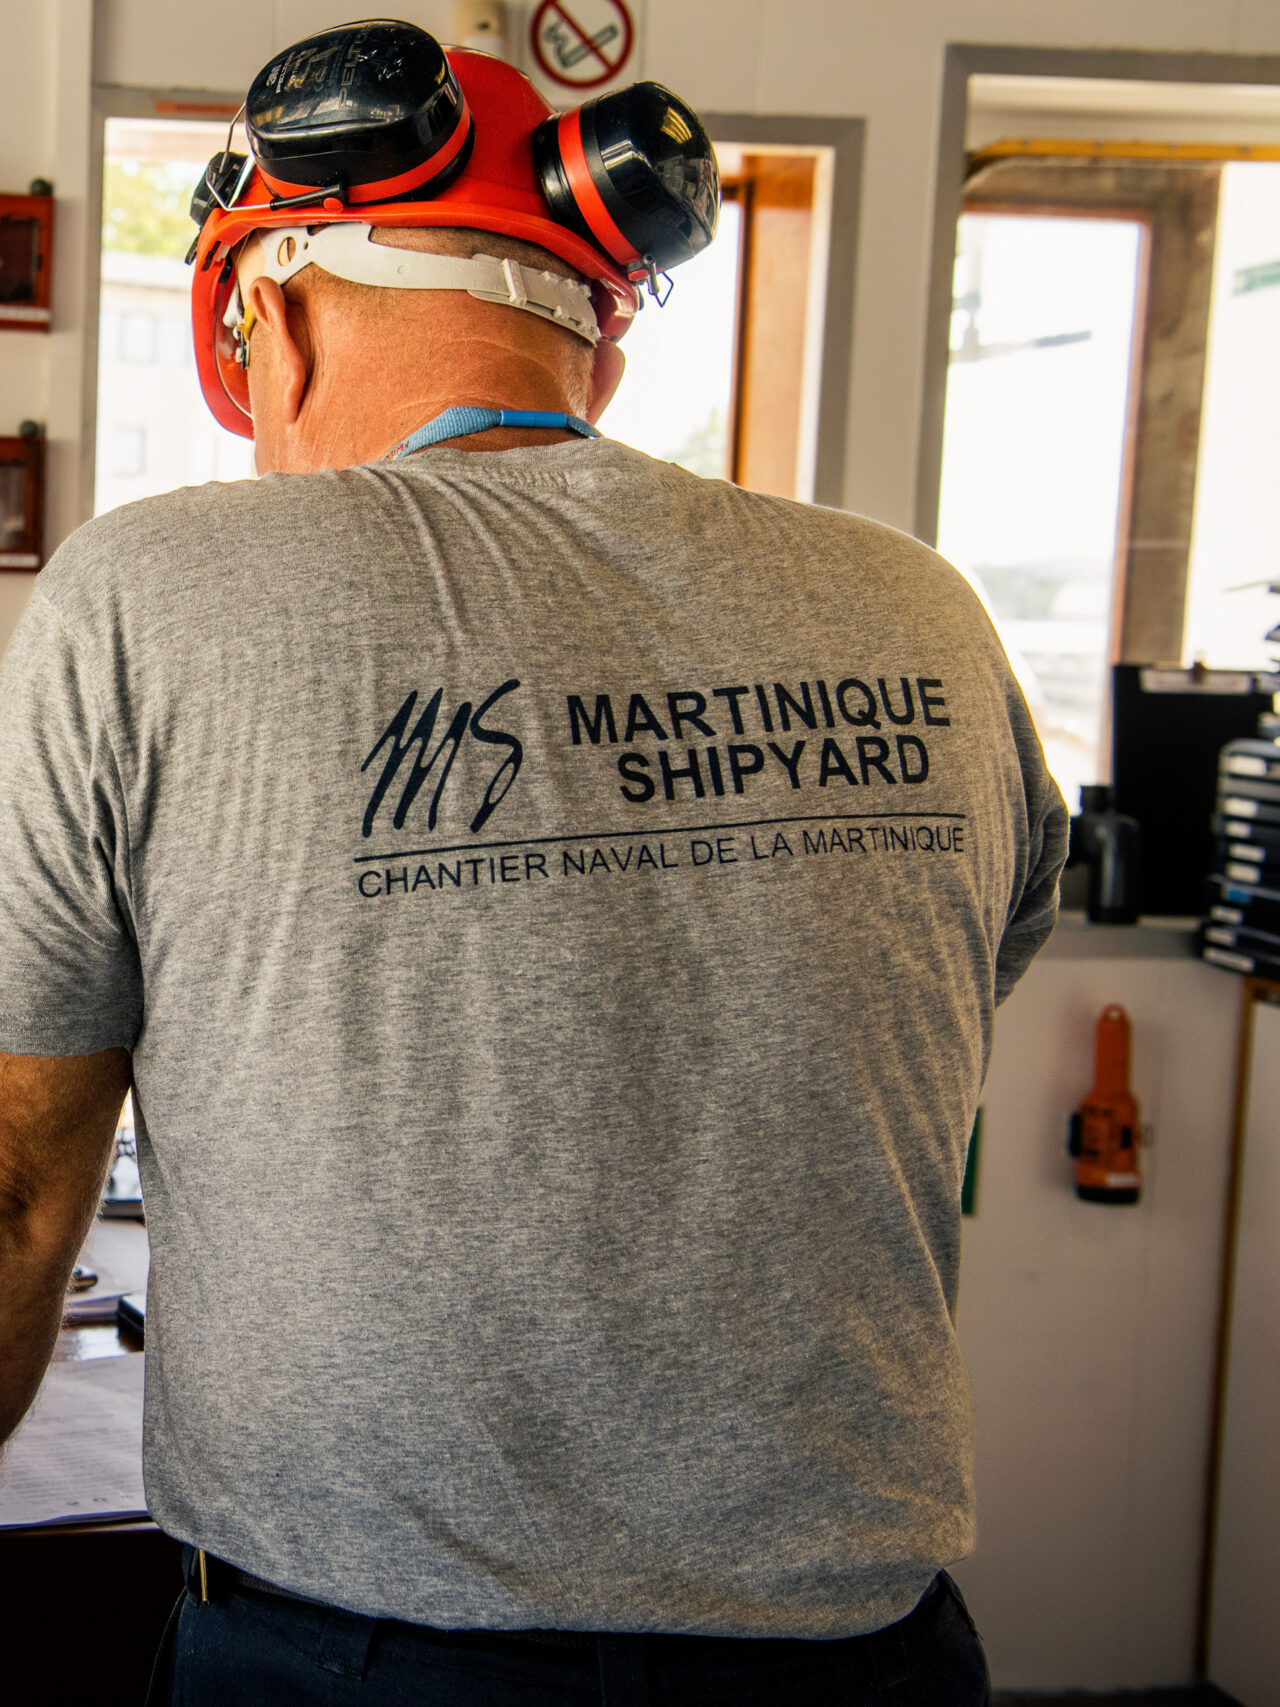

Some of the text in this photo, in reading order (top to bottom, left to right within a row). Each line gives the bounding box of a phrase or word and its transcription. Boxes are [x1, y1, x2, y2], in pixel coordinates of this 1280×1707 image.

[566, 676, 951, 747] MARTINIQUE
[616, 734, 930, 804] SHIPYARD
[357, 825, 967, 898] CHANTIER NAVAL DE LA MARTINIQUE
